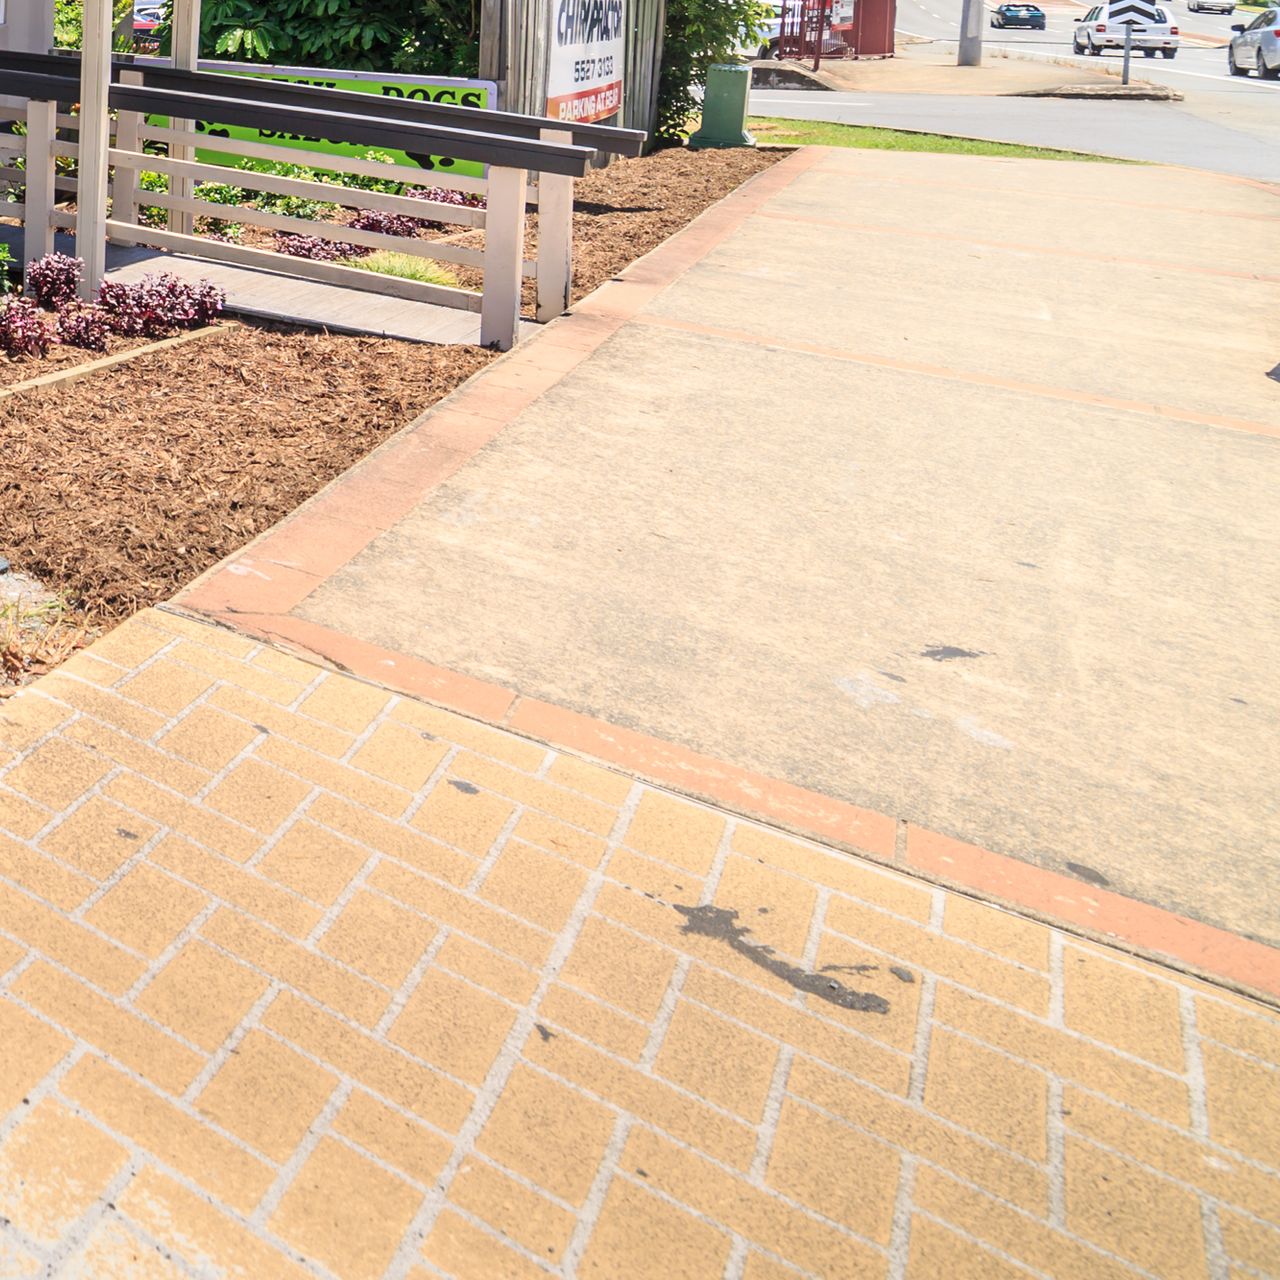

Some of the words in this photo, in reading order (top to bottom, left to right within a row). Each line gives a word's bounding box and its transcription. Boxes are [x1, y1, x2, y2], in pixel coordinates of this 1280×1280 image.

[574, 59, 596, 83] 5527
[597, 55, 613, 79] 3133
[559, 95, 596, 121] PARKING
[596, 92, 606, 113] AT
